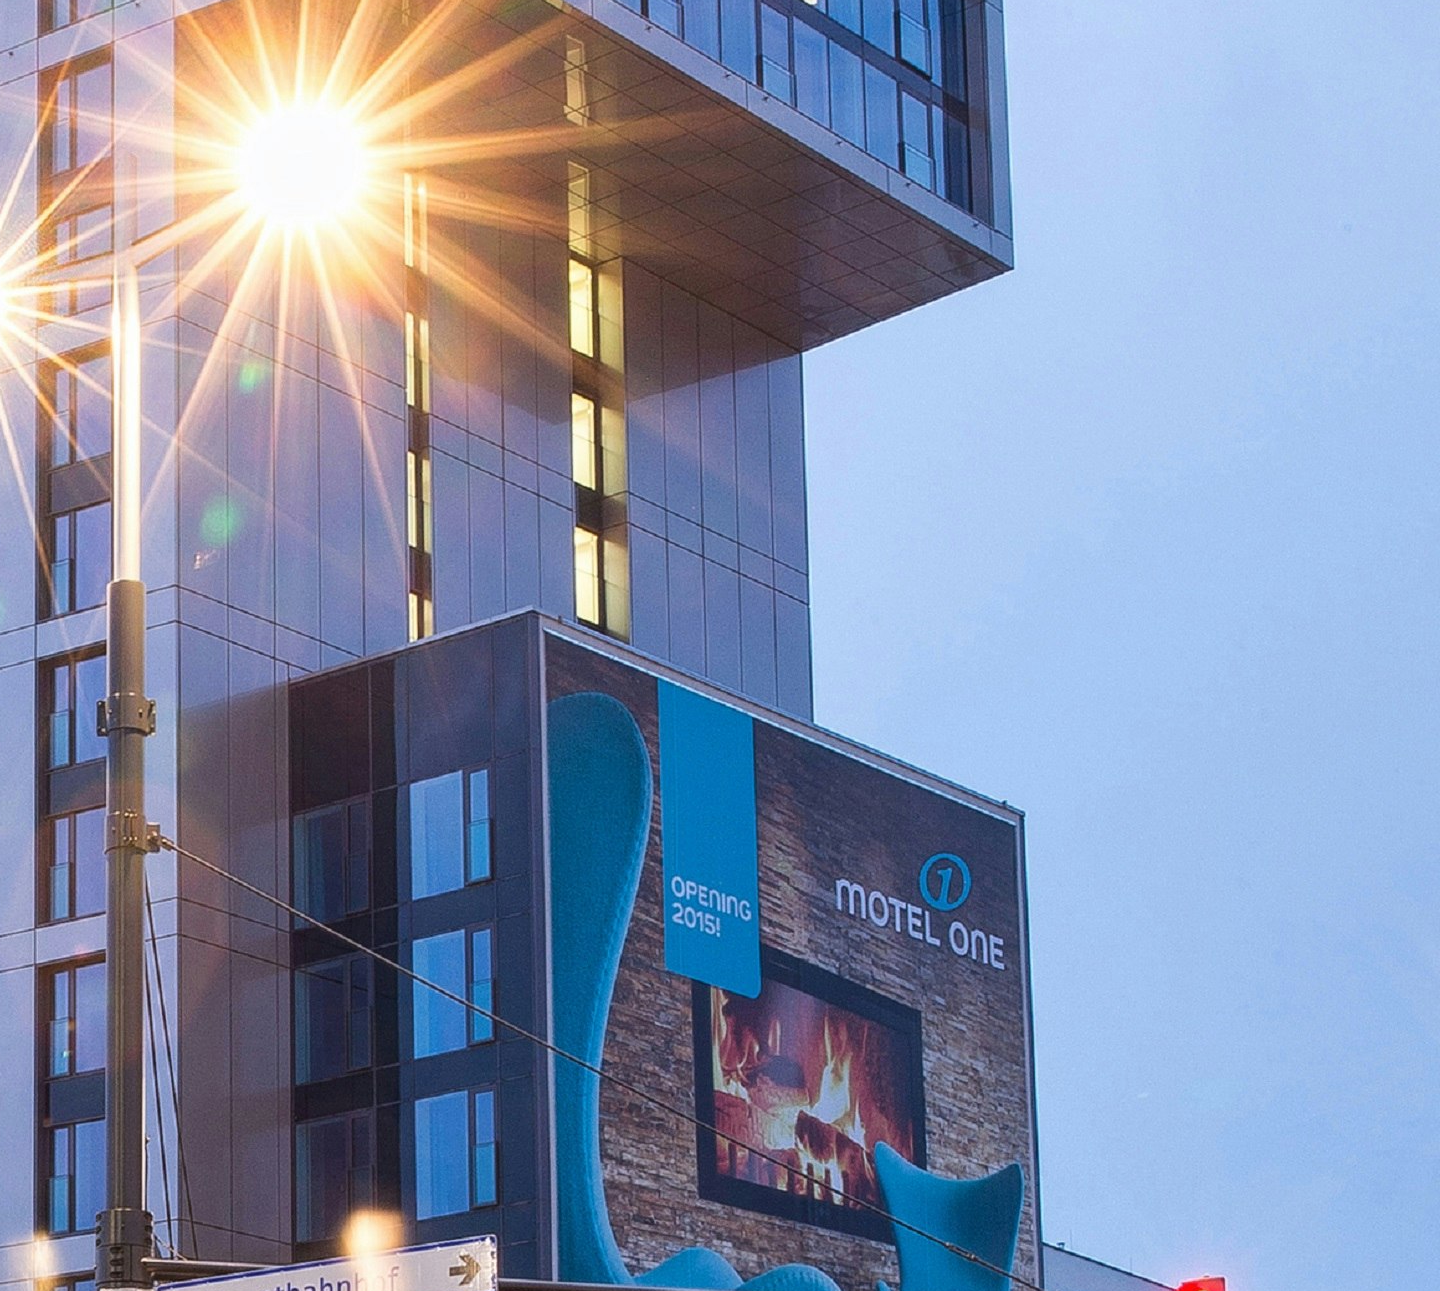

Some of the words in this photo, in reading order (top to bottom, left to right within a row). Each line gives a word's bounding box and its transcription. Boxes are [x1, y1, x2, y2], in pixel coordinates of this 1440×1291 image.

[670, 875, 752, 922] OPENING
[670, 902, 722, 938] 2015!
[834, 877, 942, 948] MOTEL
[948, 921, 1006, 971] ONE
